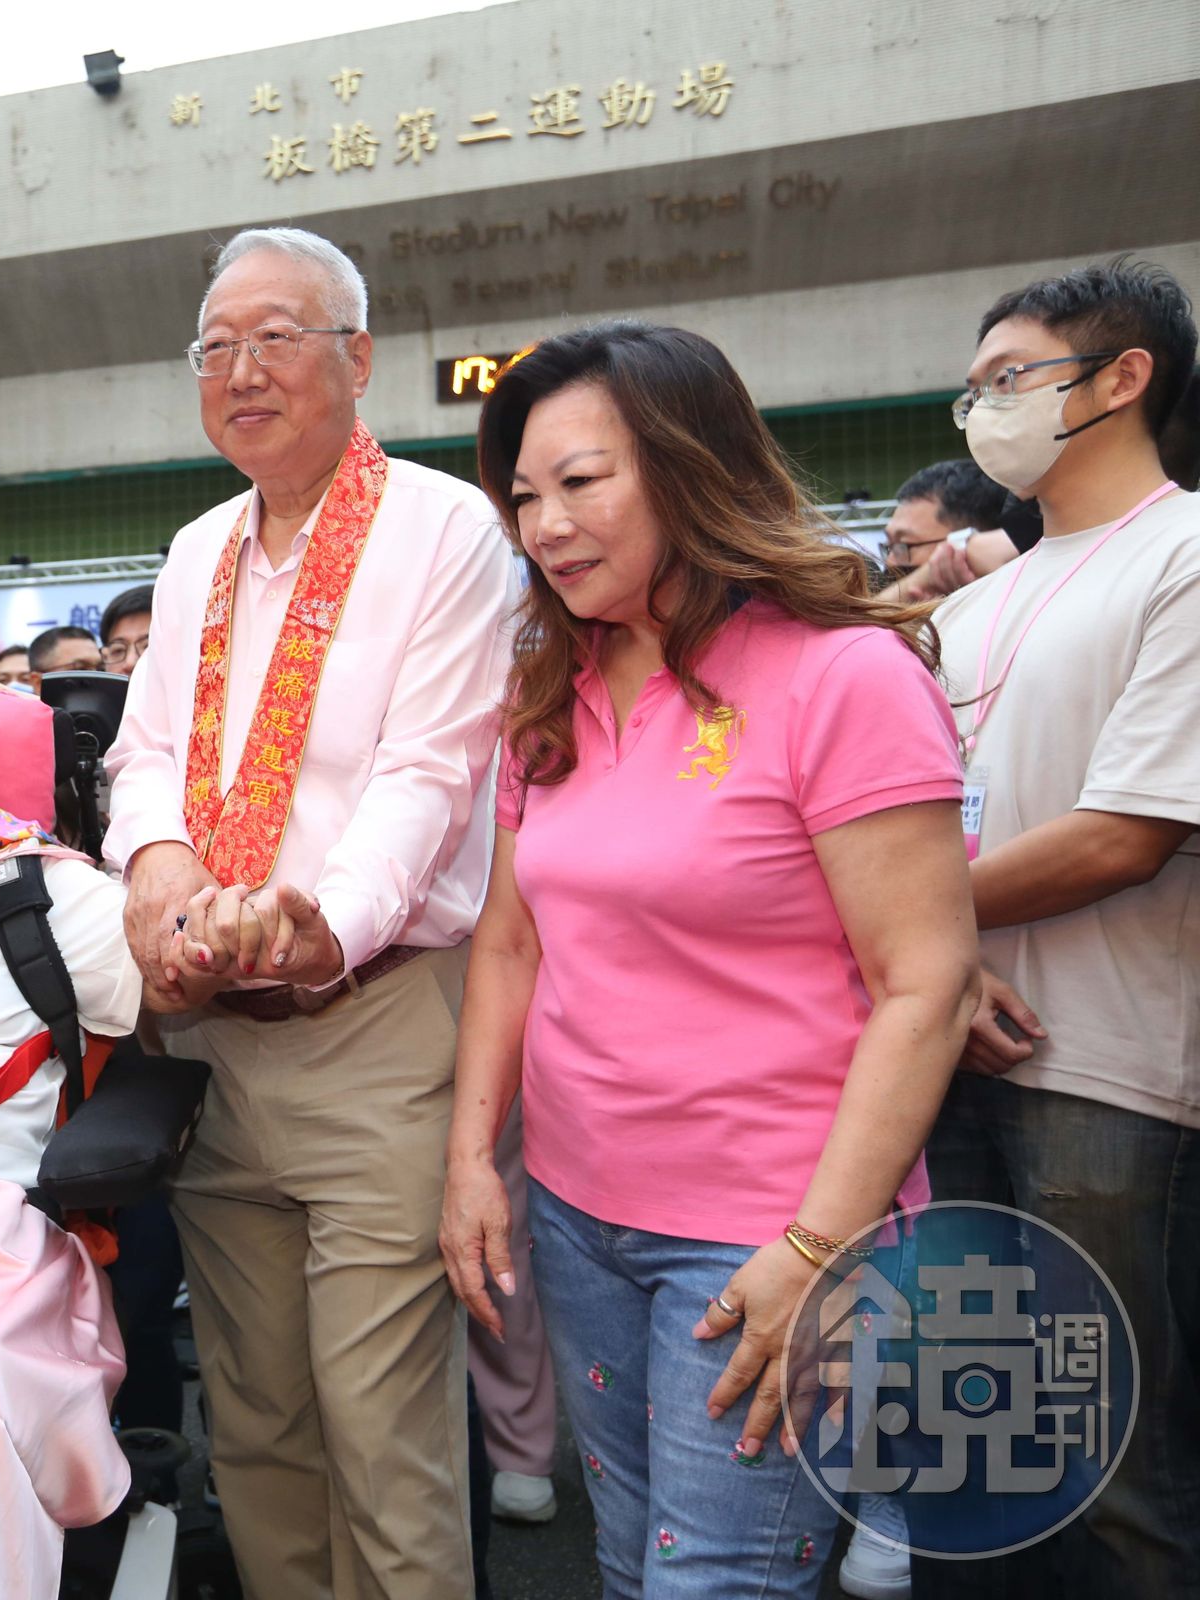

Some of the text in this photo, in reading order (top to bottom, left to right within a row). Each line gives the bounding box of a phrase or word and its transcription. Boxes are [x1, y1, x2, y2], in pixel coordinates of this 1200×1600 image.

[169, 66, 366, 128] 新北市
[262, 62, 734, 184] 板橋第二運動場
[248, 635, 313, 808] 板橋慈惠宮
